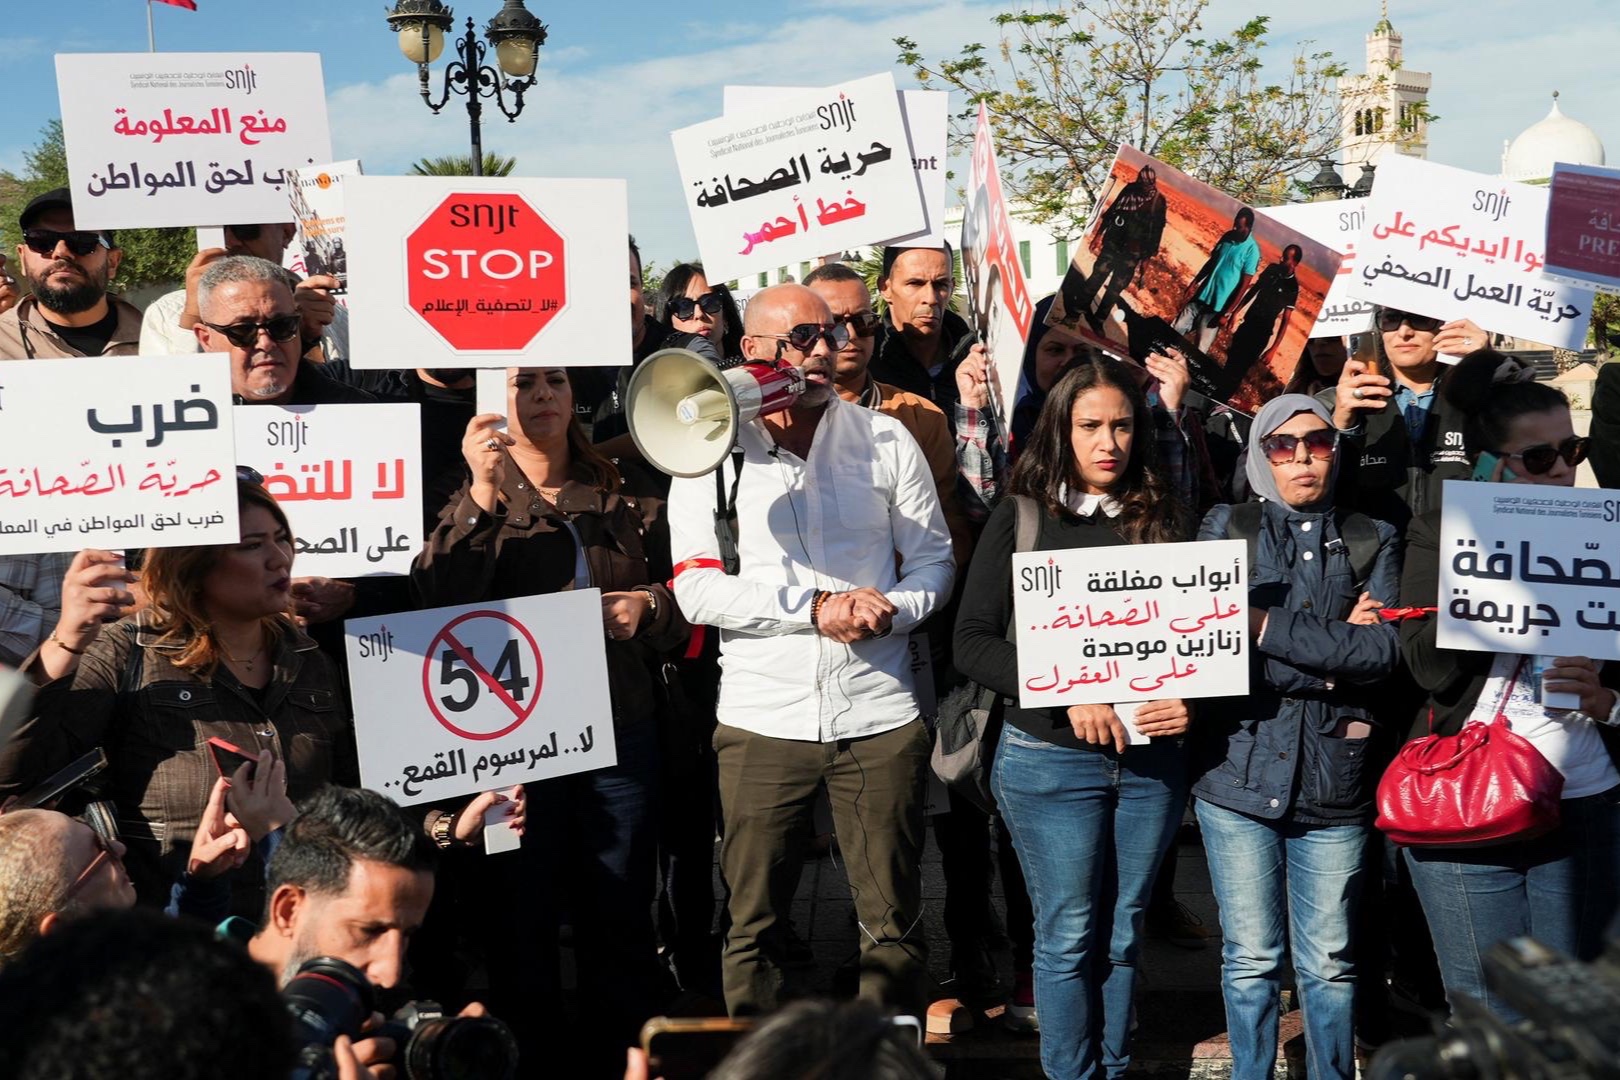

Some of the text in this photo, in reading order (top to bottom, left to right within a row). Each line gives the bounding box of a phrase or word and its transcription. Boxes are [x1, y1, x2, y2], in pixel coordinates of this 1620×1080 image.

[225, 64, 257, 94] snjt
[114, 107, 287, 145] منع المعلومة
[816, 91, 857, 133] snjt
[88, 161, 196, 197] المواطن
[205, 160, 254, 193] لحق
[693, 141, 892, 208] حرية الصحافة
[450, 204, 519, 234] snjt
[1339, 204, 1366, 232] sn
[1472, 188, 1512, 221] snjt
[738, 190, 866, 256] خط أحمر
[1373, 211, 1416, 240] على
[1420, 225, 1509, 264] ايديكم
[1579, 234, 1620, 256] PRE
[422, 249, 554, 280] STOP
[1362, 253, 1451, 291] الصحفي
[1454, 274, 1522, 307] العمل
[1317, 301, 1375, 322] حفيين
[87, 384, 218, 447] ضرب
[267, 414, 309, 453] snjt
[1444, 431, 1465, 450] sn
[1360, 454, 1386, 466] صحاف
[263, 459, 404, 501] لا للتض
[44, 518, 72, 539] في
[78, 514, 145, 533] المواطن
[151, 512, 181, 531] لحق
[187, 511, 224, 530] ضرب
[293, 526, 410, 563] على الصح
[1021, 557, 1062, 598] snjt
[1087, 558, 1240, 594] أبواب مغلقة
[1452, 539, 1620, 588] صّحافة
[1449, 588, 1561, 636] جريمة
[359, 624, 394, 662] snjt
[1082, 630, 1241, 661] زنازين موصدة
[440, 638, 530, 712] 54
[1025, 660, 1120, 693] العقول
[472, 731, 559, 783] لمرسوم
